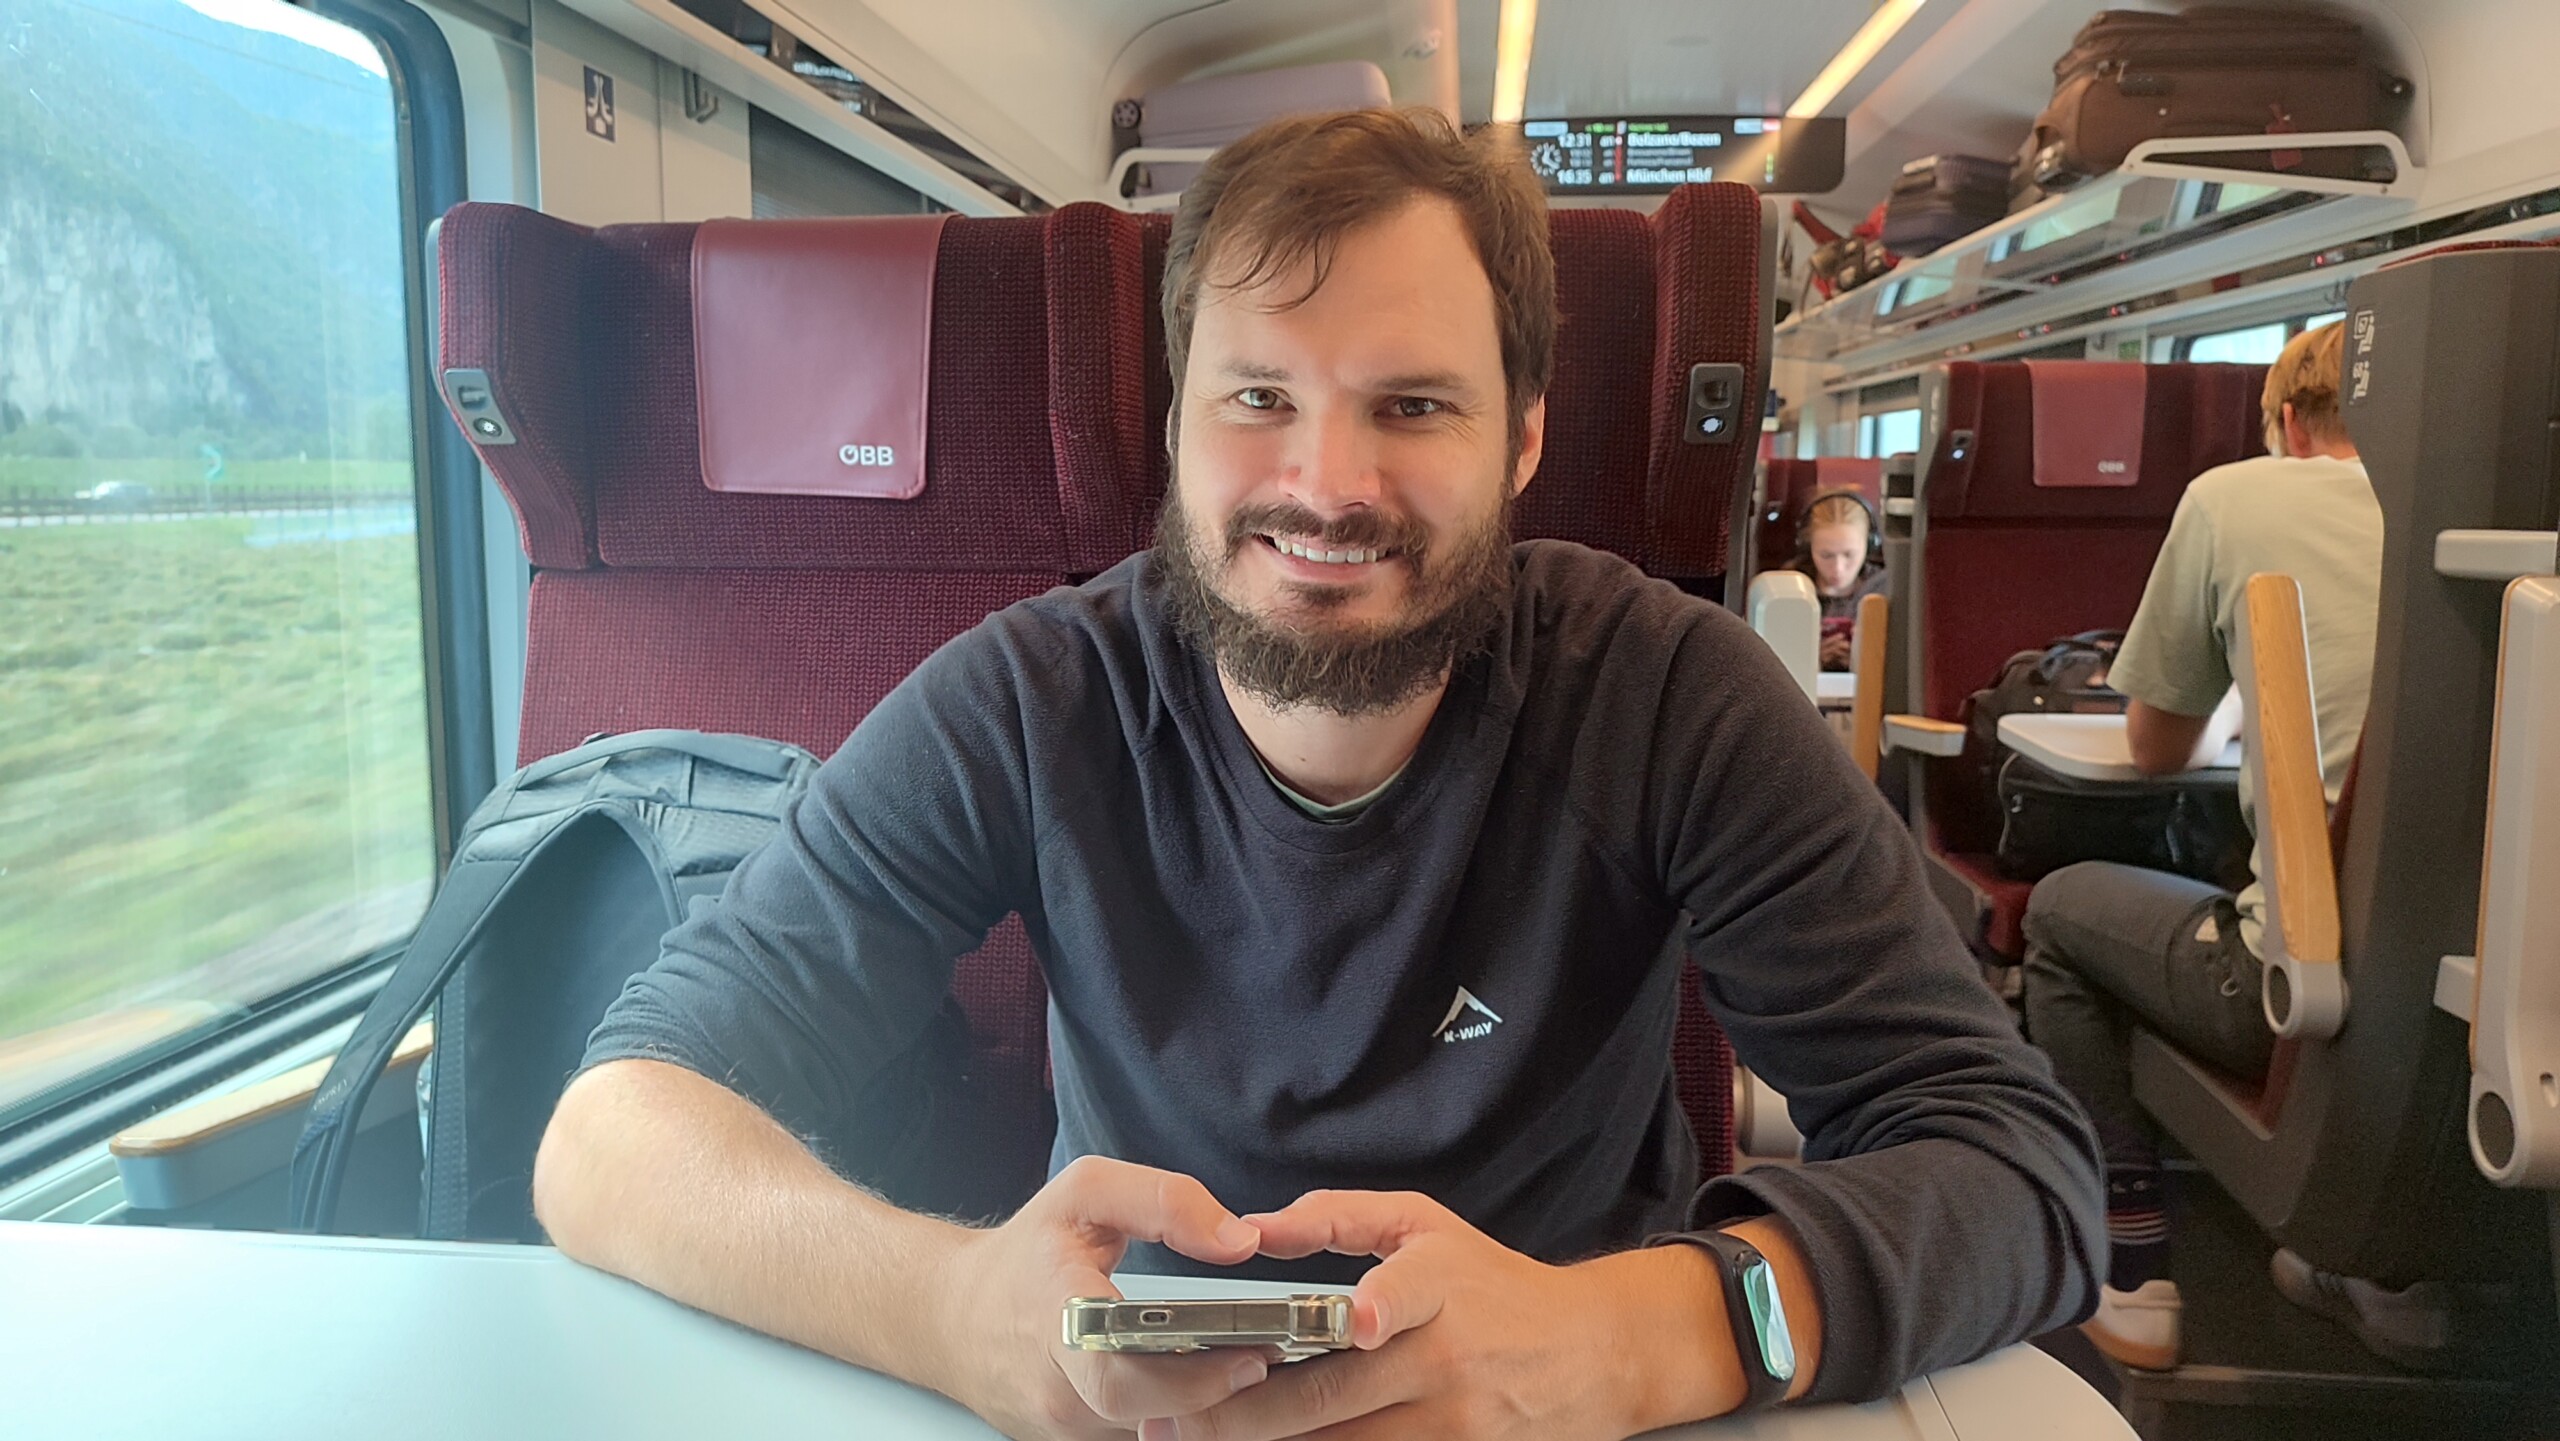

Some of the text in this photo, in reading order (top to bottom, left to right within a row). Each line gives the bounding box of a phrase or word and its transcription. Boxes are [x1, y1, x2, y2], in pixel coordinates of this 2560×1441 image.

[1627, 132, 1722, 147] Bolzano/Bozen
[1626, 168, 1686, 184] München
[1686, 167, 1713, 183] Hbf
[1443, 1021, 1493, 1043] K-WAY
